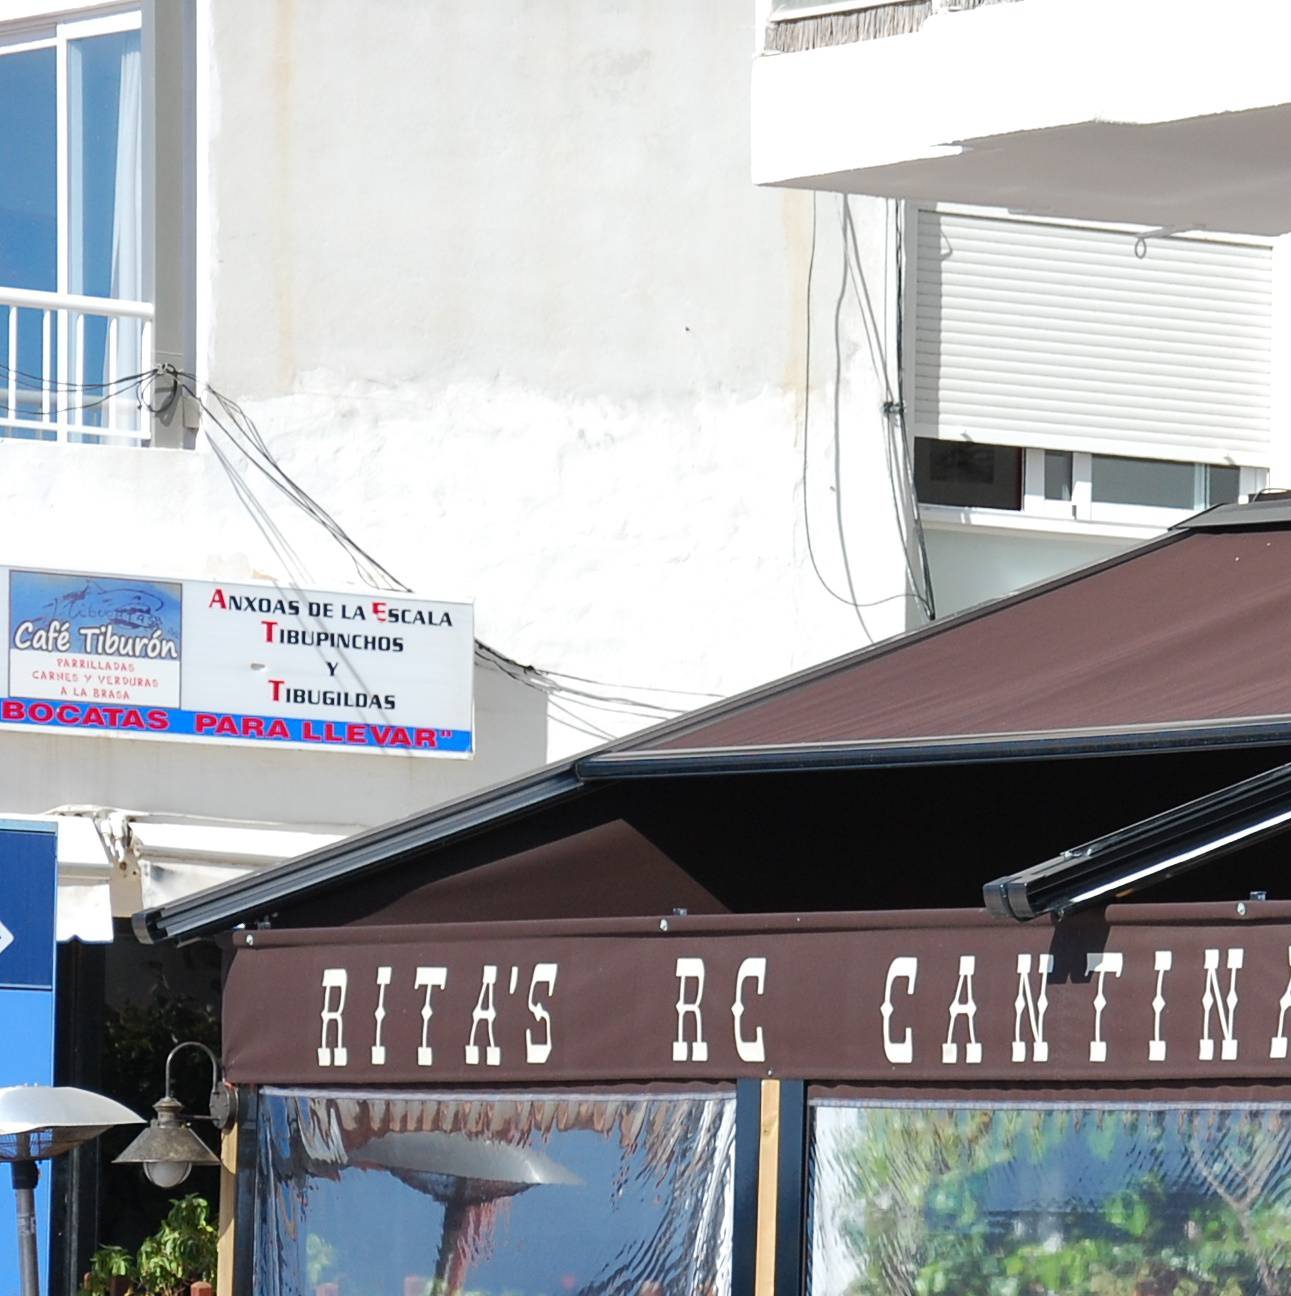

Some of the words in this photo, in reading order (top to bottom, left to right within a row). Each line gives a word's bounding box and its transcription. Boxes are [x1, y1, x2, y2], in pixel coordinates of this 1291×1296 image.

[208, 588, 300, 616] ANXOAS
[308, 602, 334, 618] DE
[341, 604, 366, 621] LA
[372, 602, 453, 627] ESCALA
[14, 619, 71, 652] Café
[79, 625, 178, 660] Tiburón
[261, 620, 404, 653] TIBUPINCHOS
[32, 671, 79, 683] CARNES
[84, 674, 92, 684] Y
[97, 675, 160, 688] VERDURAS
[56, 657, 135, 673] PARRILLADAS
[326, 661, 339, 677] Y
[60, 686, 68, 696] A
[73, 687, 88, 697] LA
[93, 688, 130, 700] BRASA
[268, 680, 396, 711] TIBUGILDAS
[2, 701, 169, 731] BOCATAS
[195, 713, 290, 738] PARA
[318, 963, 558, 1066] RITA'S
[672, 957, 767, 1062] RC
